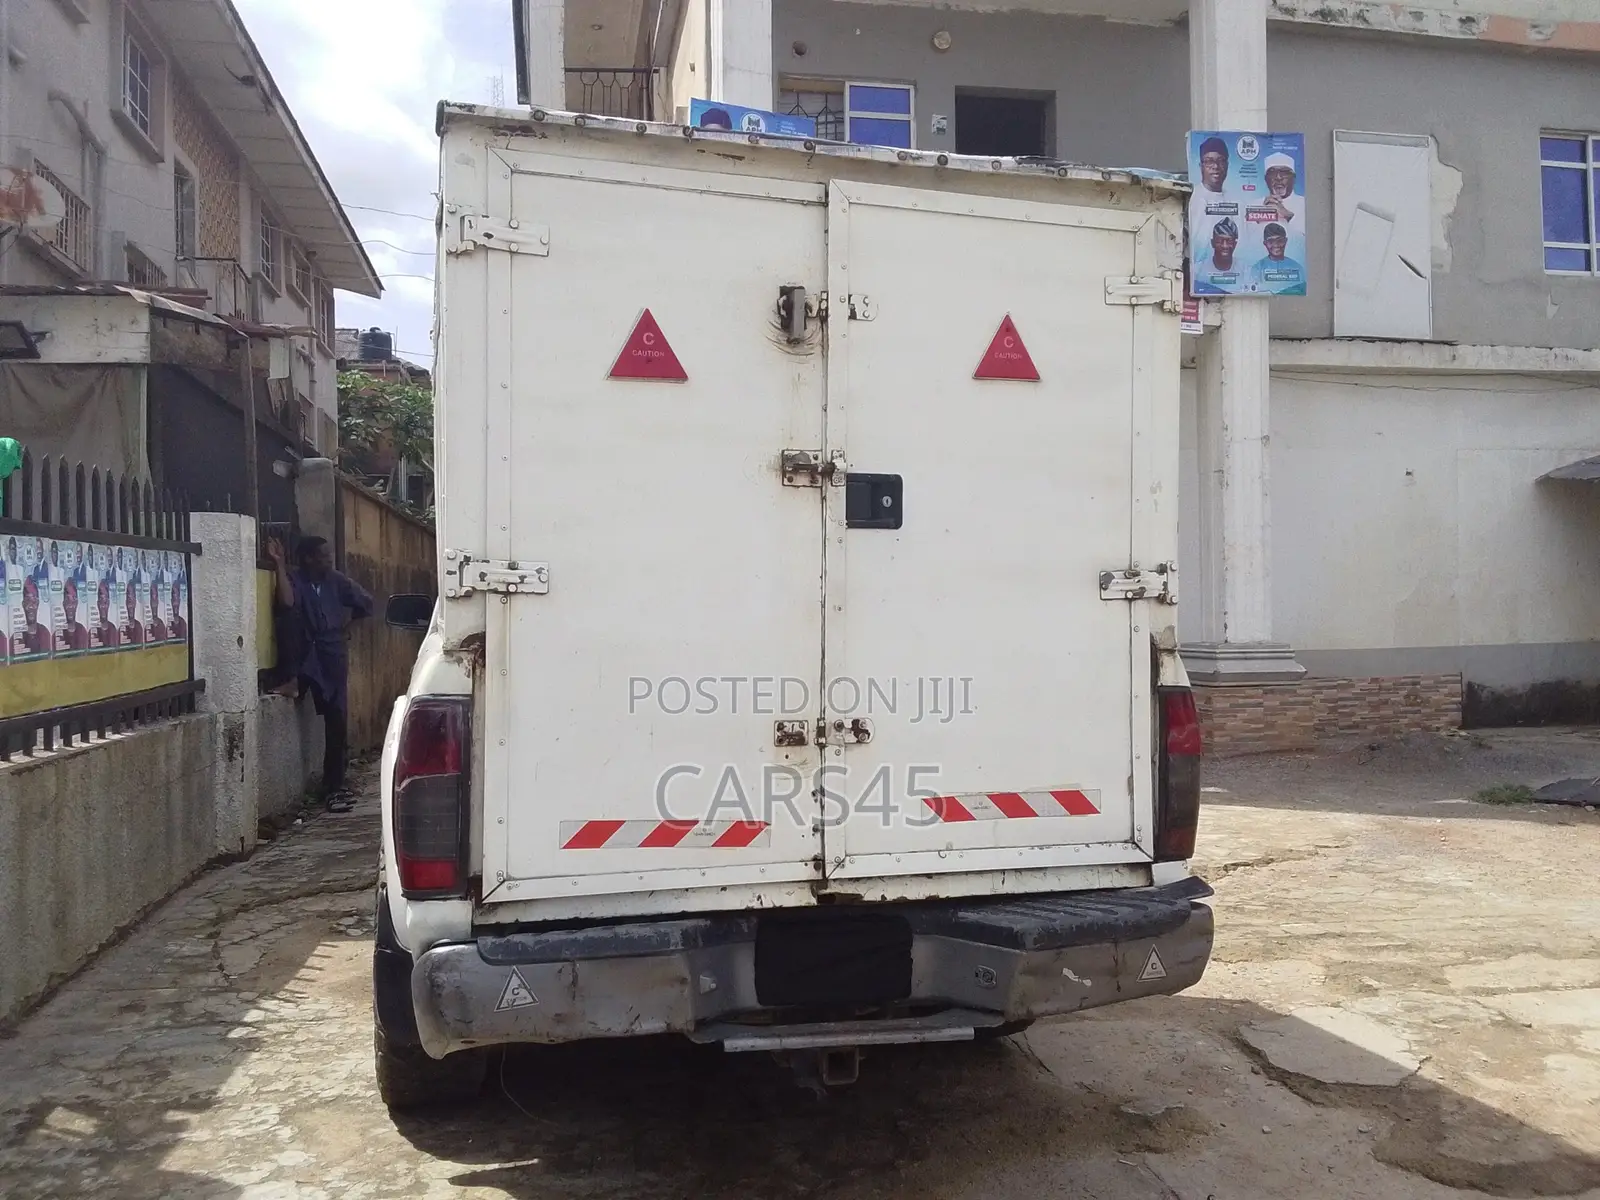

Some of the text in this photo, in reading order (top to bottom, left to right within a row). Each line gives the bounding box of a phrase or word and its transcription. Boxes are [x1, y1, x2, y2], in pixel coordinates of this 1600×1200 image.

[1248, 212, 1277, 220] SENATE
[643, 332, 655, 345] C
[1004, 336, 1014, 348] C
[632, 349, 665, 358] CAUTION
[994, 352, 1022, 360] CAUTION
[1151, 962, 1157, 970] C
[511, 987, 520, 996] C
